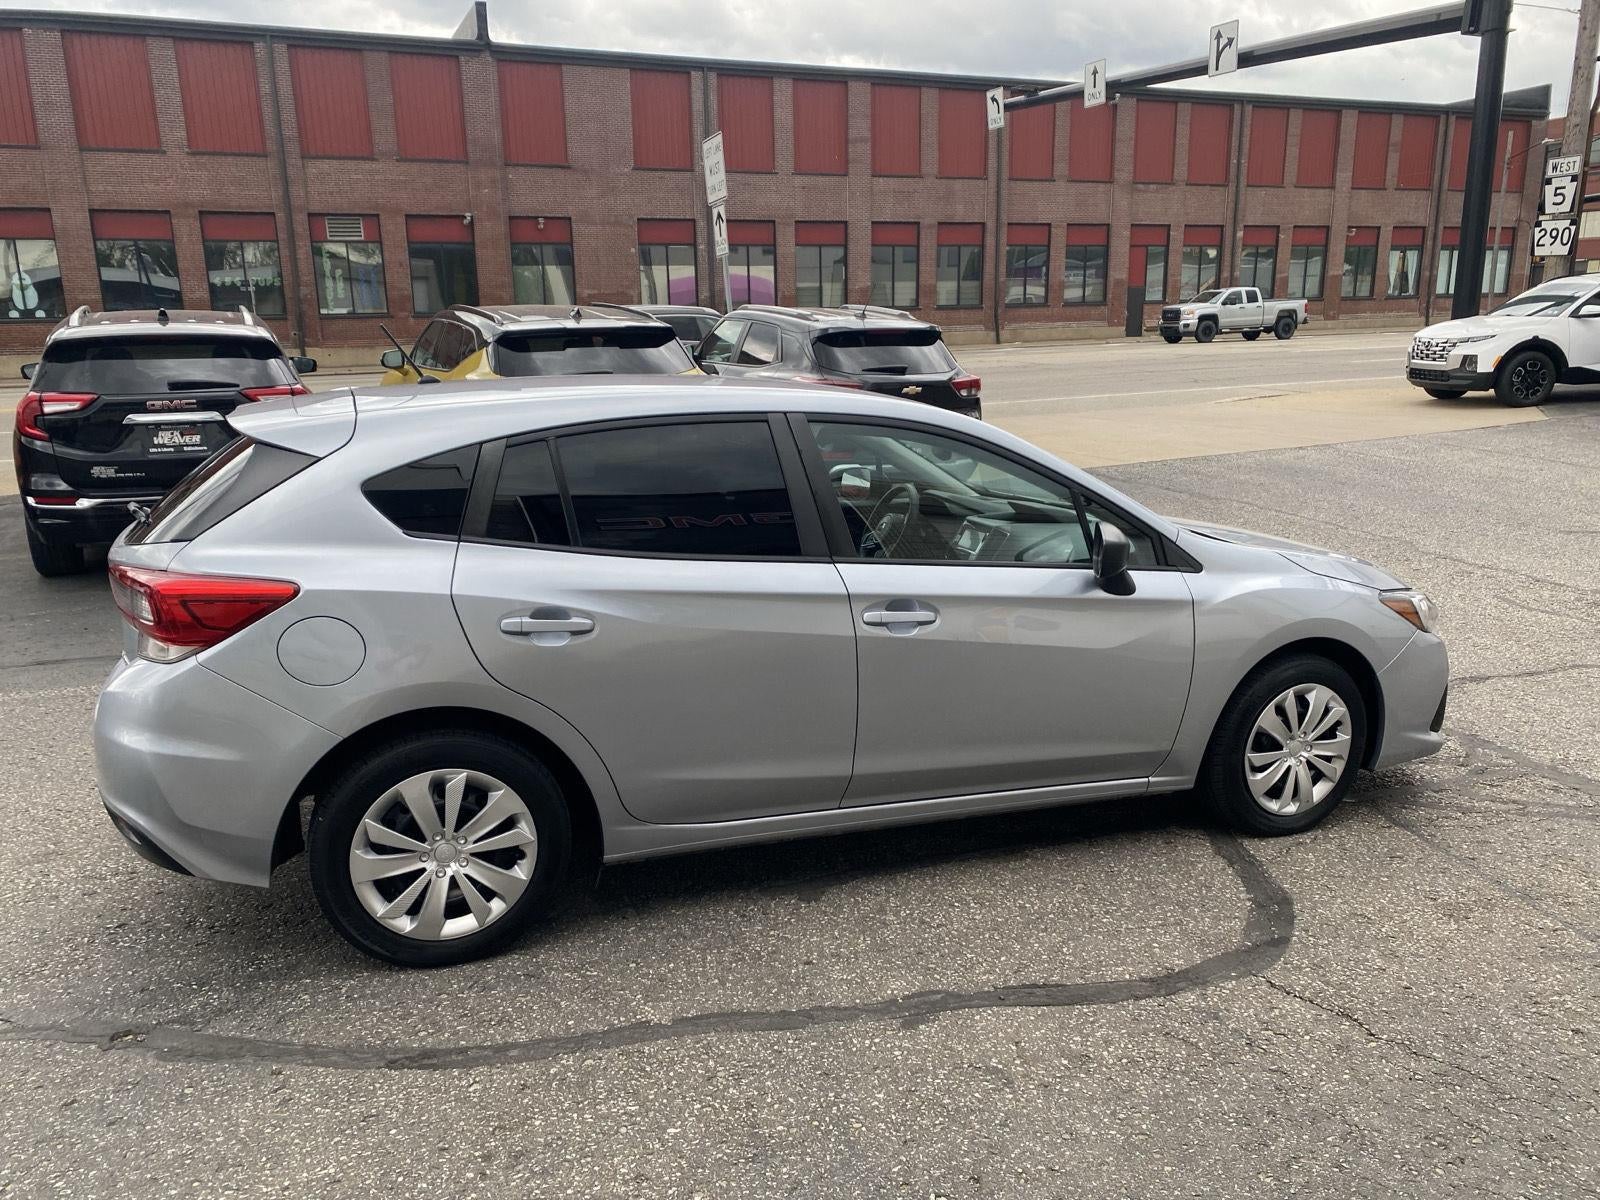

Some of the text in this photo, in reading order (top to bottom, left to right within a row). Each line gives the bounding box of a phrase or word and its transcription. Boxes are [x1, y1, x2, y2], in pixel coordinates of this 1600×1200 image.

[1087, 90, 1102, 102] ONLY
[990, 116, 1002, 126] ONLY
[709, 160, 720, 176] MUST
[1551, 160, 1577, 174] WEST
[1552, 186, 1566, 206] 5
[1536, 227, 1571, 247] 290
[146, 399, 197, 410] GMC
[153, 434, 201, 445] WEAVER
